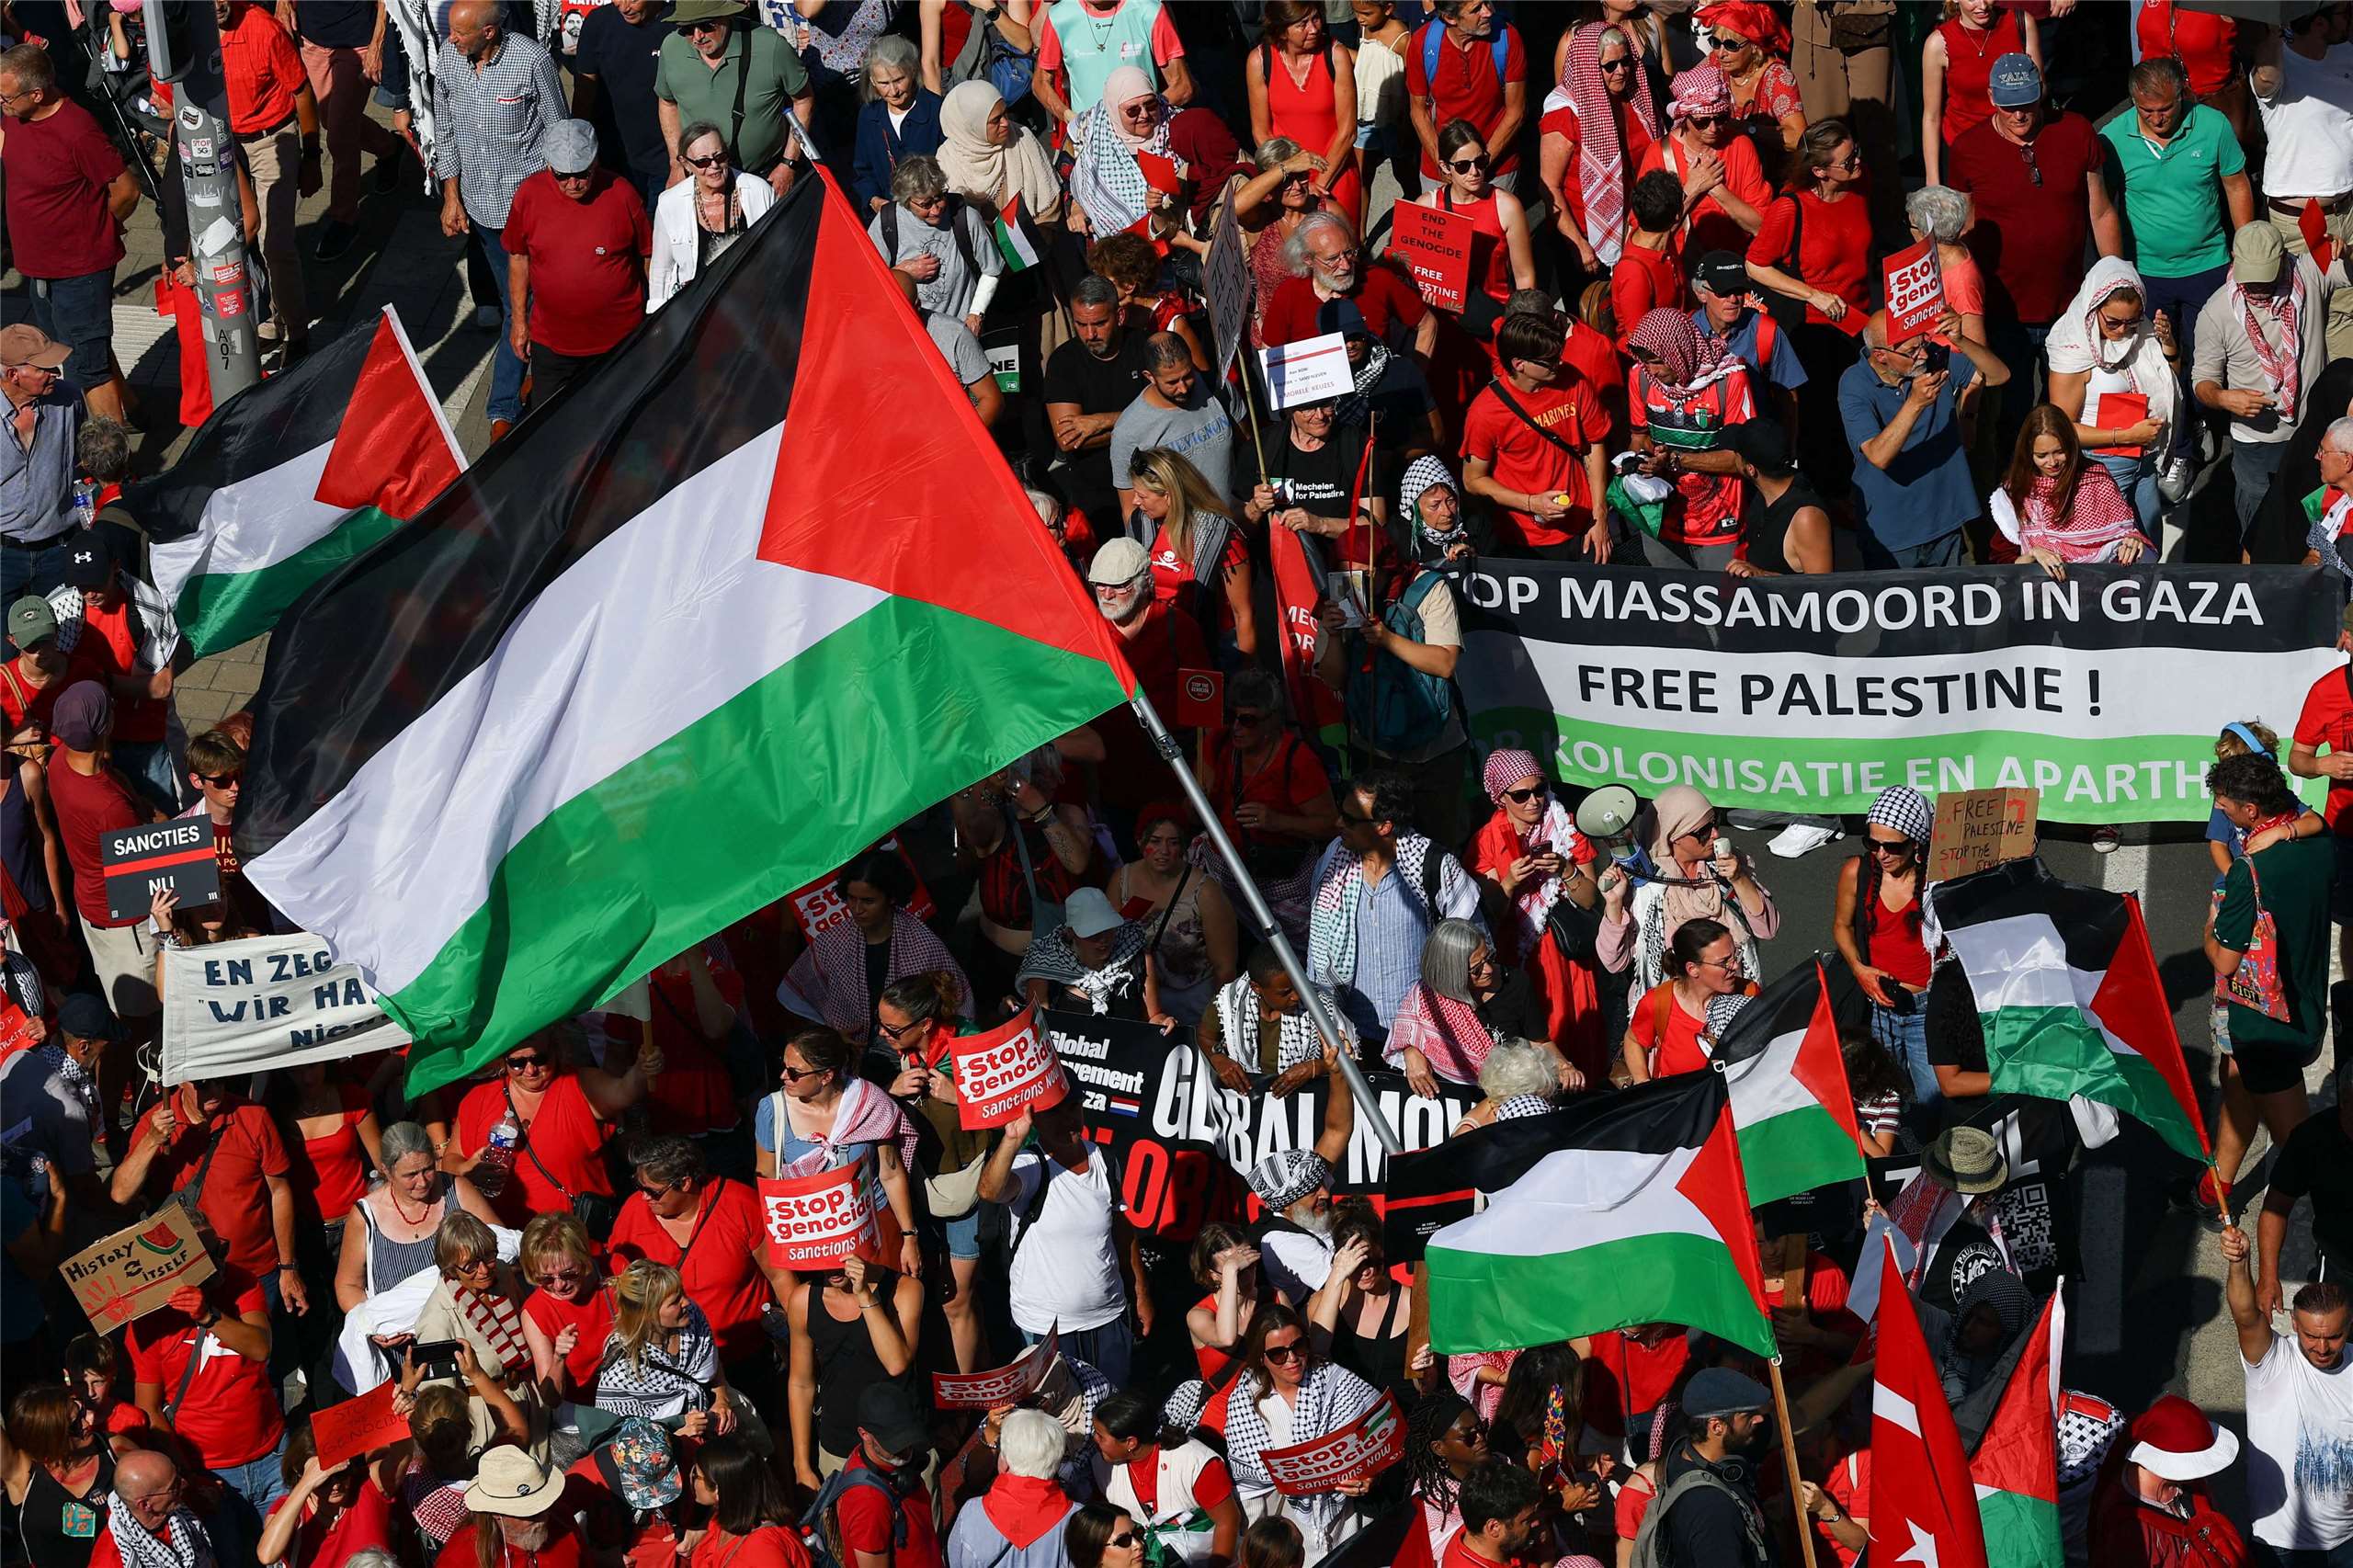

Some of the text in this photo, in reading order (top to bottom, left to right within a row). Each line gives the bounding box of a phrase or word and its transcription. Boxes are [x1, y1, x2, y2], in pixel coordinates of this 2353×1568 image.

[1421, 212, 1447, 226] END
[1421, 226, 1445, 240] THE
[1400, 235, 1462, 259] GENOCIDE
[1414, 266, 1443, 281] FREE
[1895, 277, 1938, 312] geno
[1903, 301, 1942, 331] sanctio
[1295, 483, 1335, 491] Mechelen
[1295, 490, 1345, 500] for Palestine
[1448, 571, 2264, 634] OP MASSAMOORD IN GAZA
[1577, 664, 2101, 717] FREE PALESTINE !
[1543, 730, 1886, 797] KOLONISATIE
[1905, 755, 1975, 792] EN
[1994, 759, 2303, 803] APARTH
[1954, 799, 1998, 822] FREE
[113, 824, 200, 856] SANCTIES
[1963, 819, 2026, 839] PALESTINE
[1939, 846, 1970, 861] STOP
[204, 950, 333, 986] EN ZEG
[314, 977, 377, 1010] HA
[2232, 980, 2256, 1002] RIOT
[968, 1036, 1029, 1078] Stop
[969, 1039, 1052, 1098] genocide
[1060, 1060, 1144, 1095] vement
[982, 1081, 1044, 1119] sanctions
[1082, 1090, 1108, 1111] za
[775, 1190, 845, 1220] Stop
[777, 1195, 871, 1240] genocide
[789, 1236, 856, 1261] sanctions
[949, 1370, 1020, 1392] Stop
[1279, 1439, 1348, 1470] Stop
[1282, 1426, 1390, 1481] genocide
[1296, 1464, 1363, 1491] sanctions
[1366, 1443, 1391, 1468] NOW
